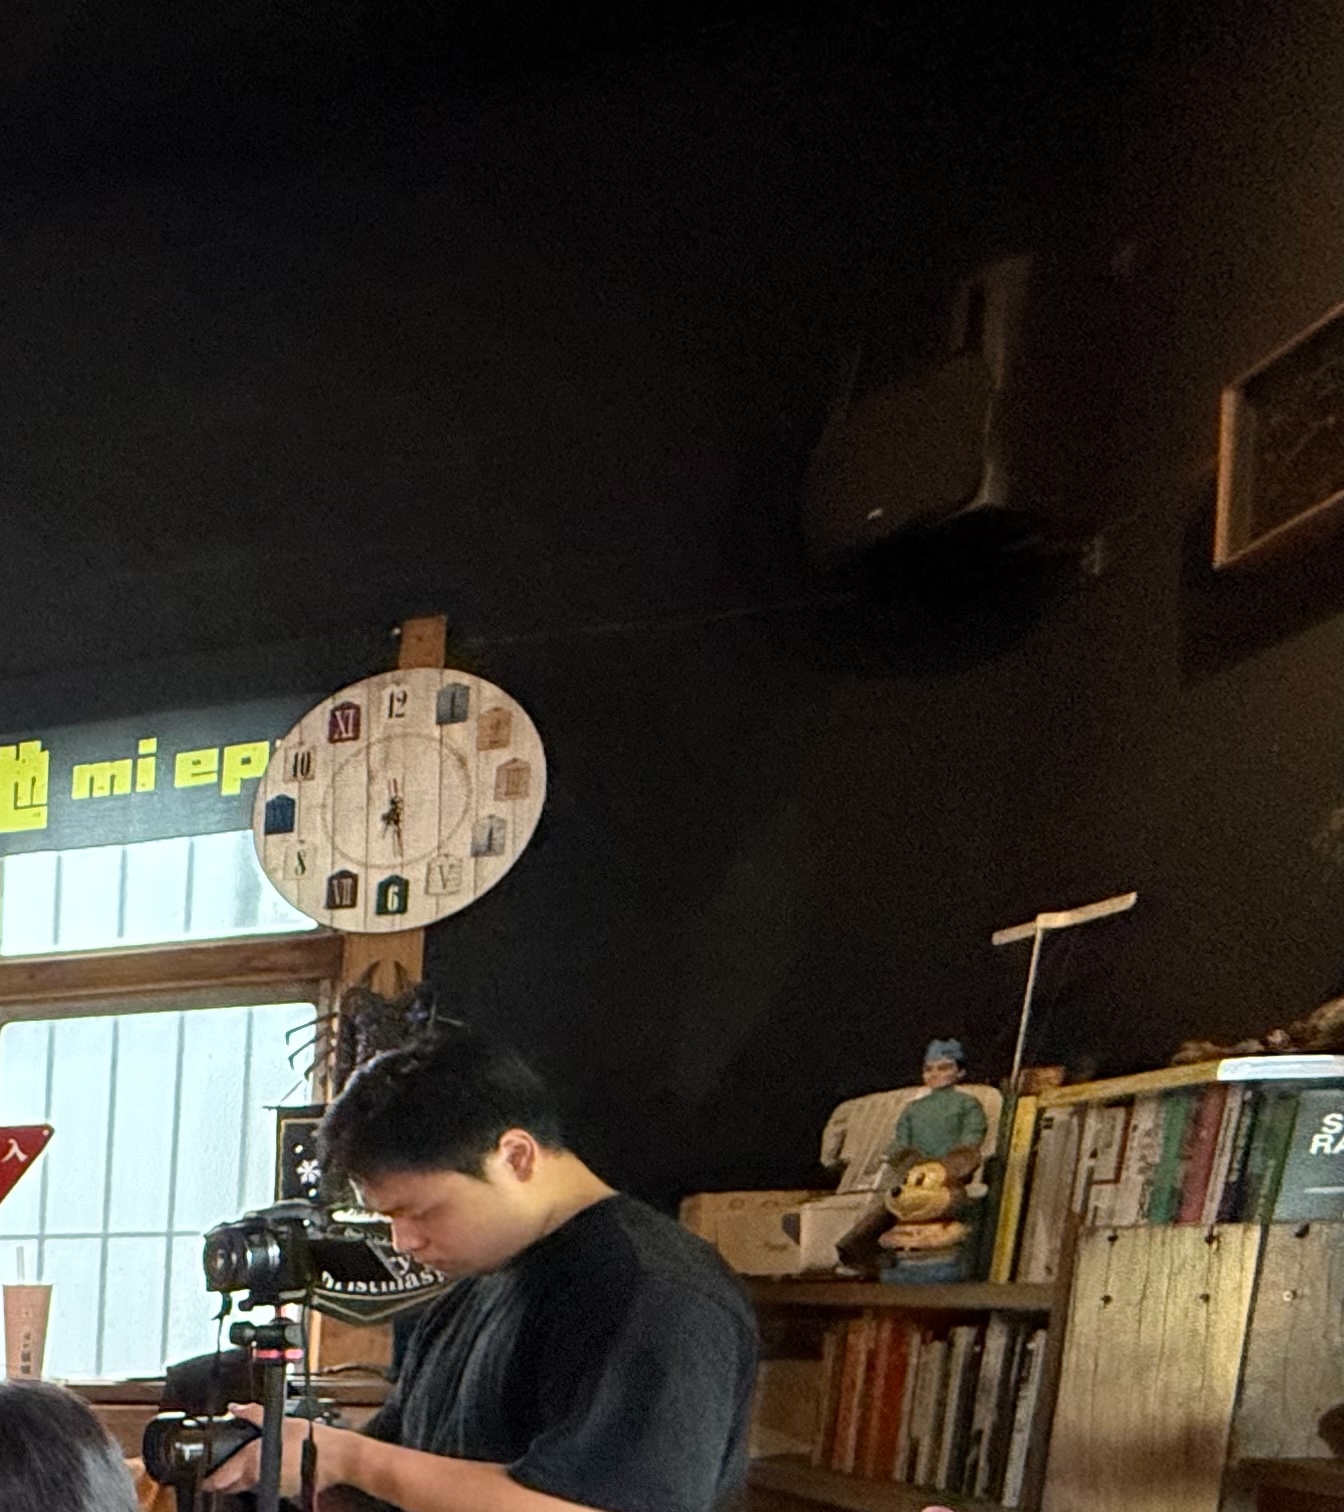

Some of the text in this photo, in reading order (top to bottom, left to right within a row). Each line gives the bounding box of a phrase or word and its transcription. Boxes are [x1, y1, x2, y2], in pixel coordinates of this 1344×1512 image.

[386, 688, 408, 720] 12
[71, 737, 157, 800] mi
[291, 750, 313, 778] 10
[387, 884, 400, 911] 6
